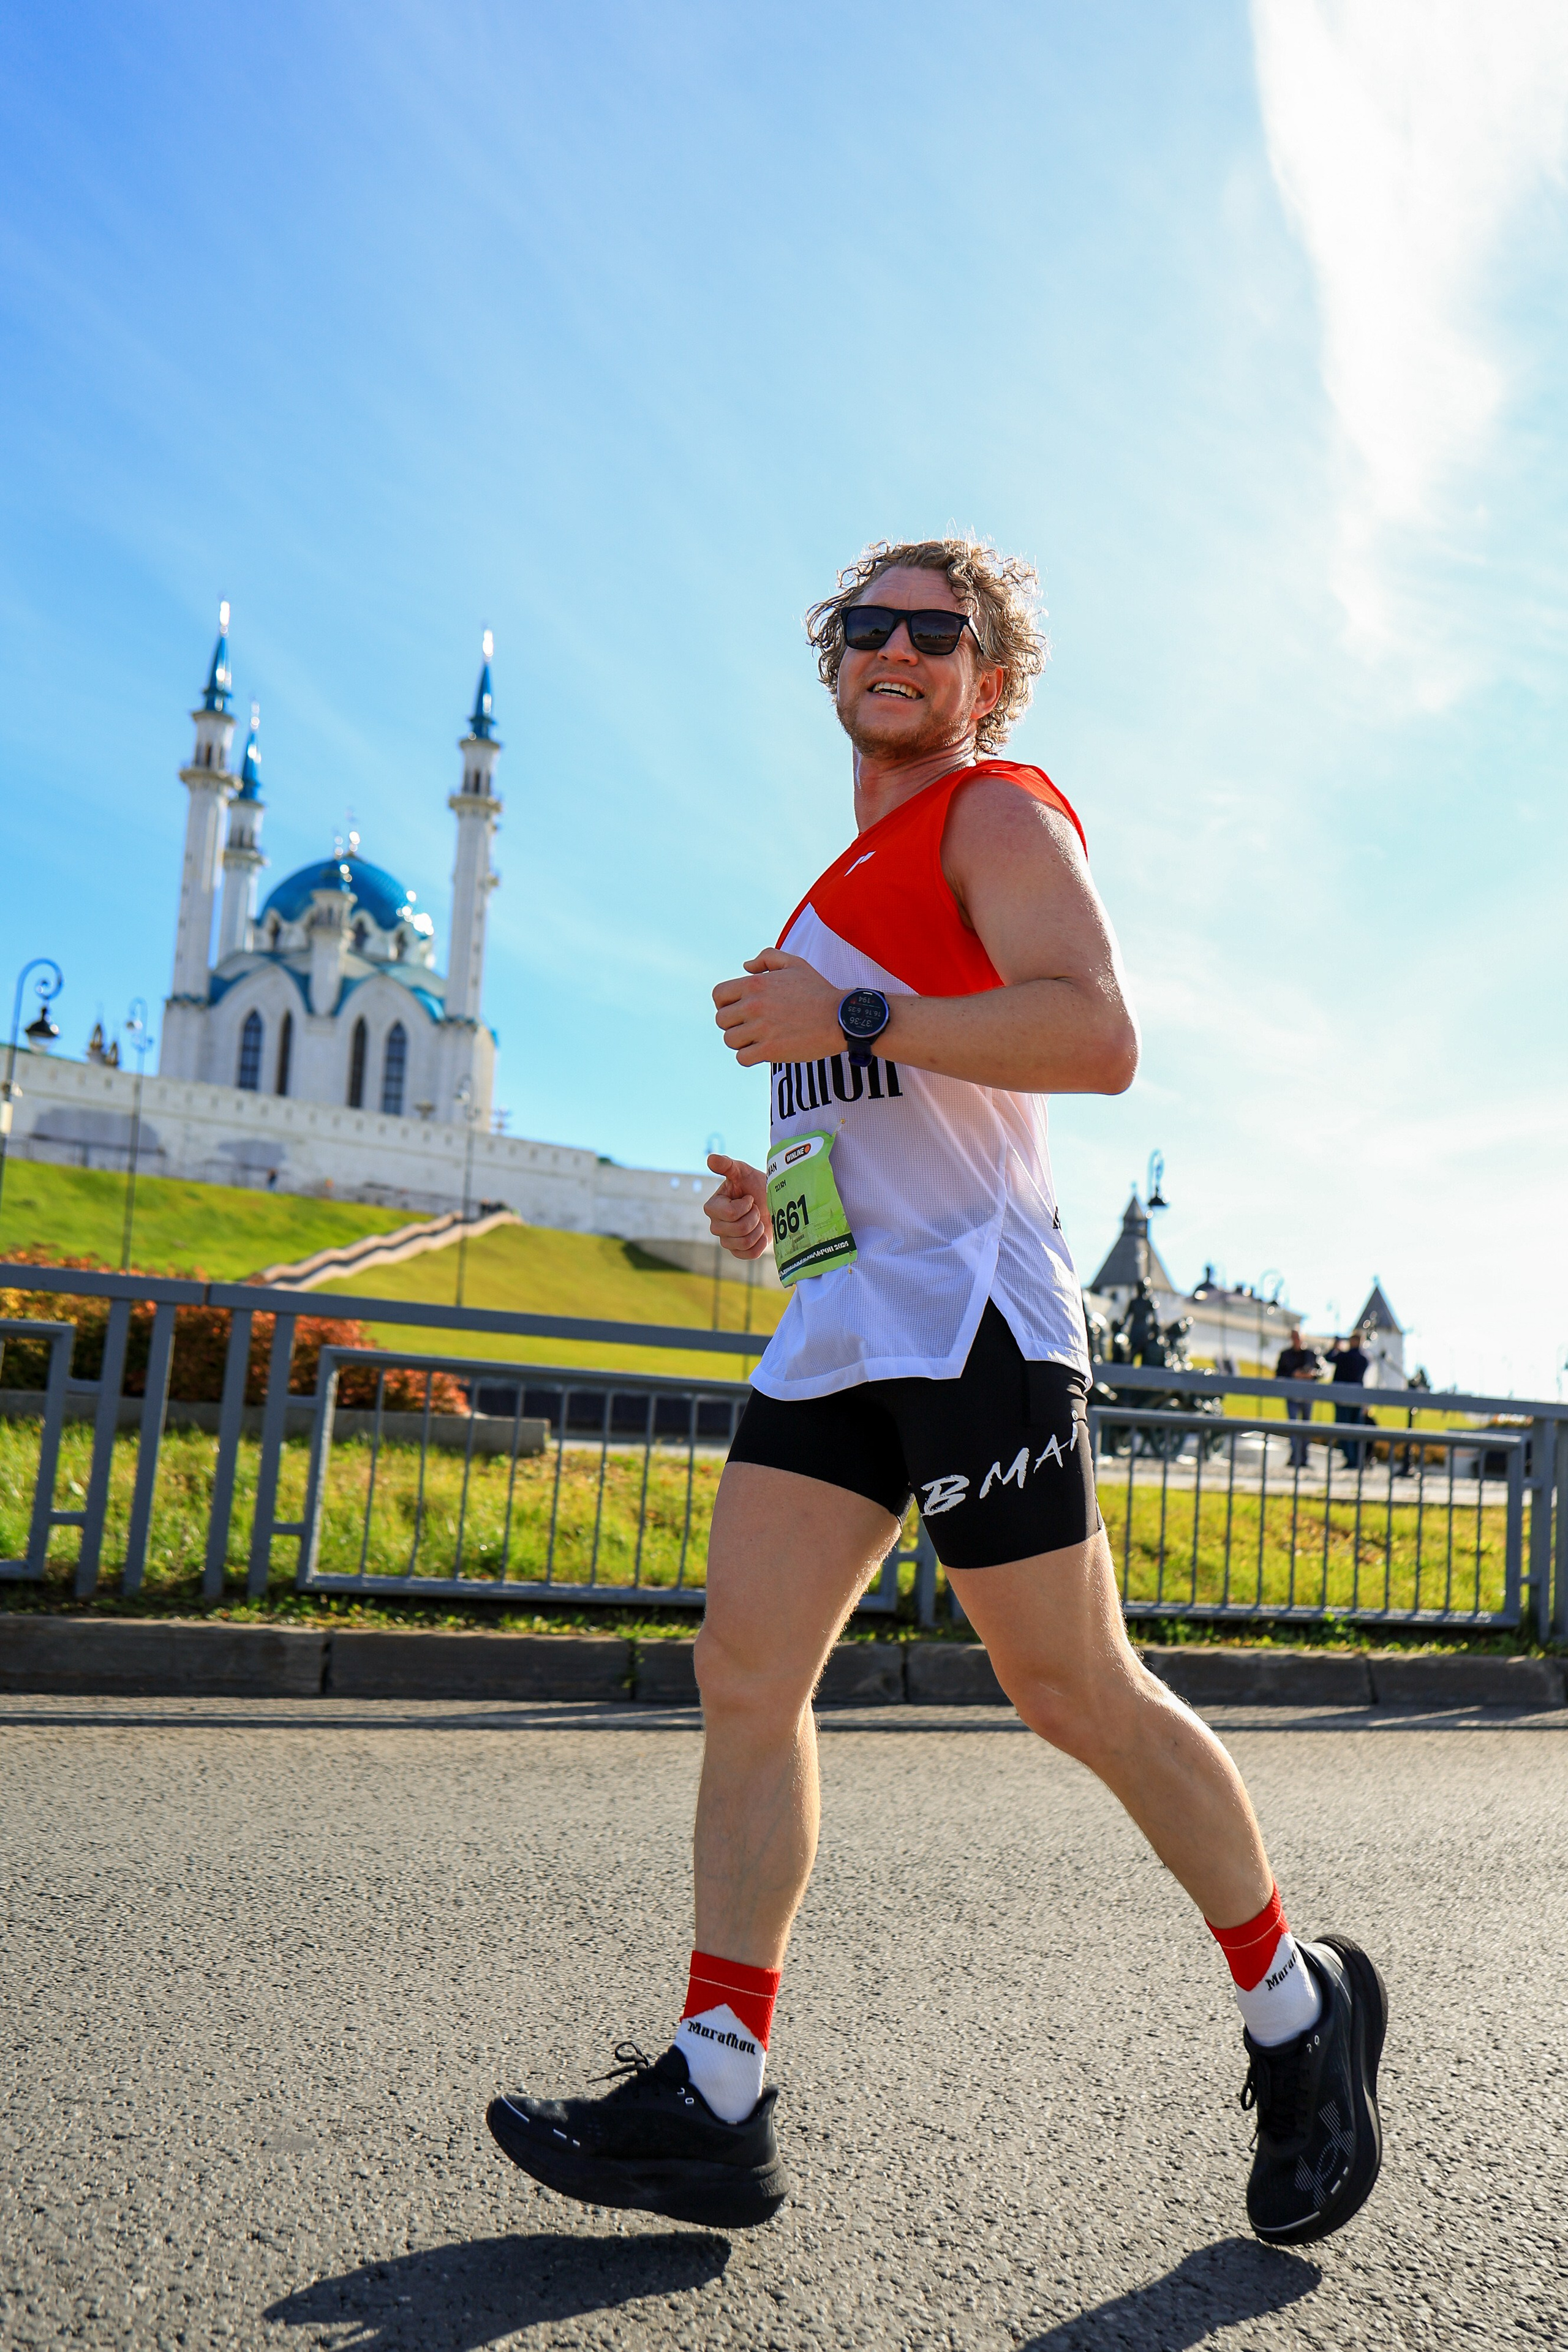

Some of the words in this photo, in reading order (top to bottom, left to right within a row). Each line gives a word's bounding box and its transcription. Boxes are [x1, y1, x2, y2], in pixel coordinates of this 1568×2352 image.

[786, 1147, 805, 1163] WINLINE
[834, 1240, 850, 1251] 2026
[687, 2021, 756, 2055] Marathon
